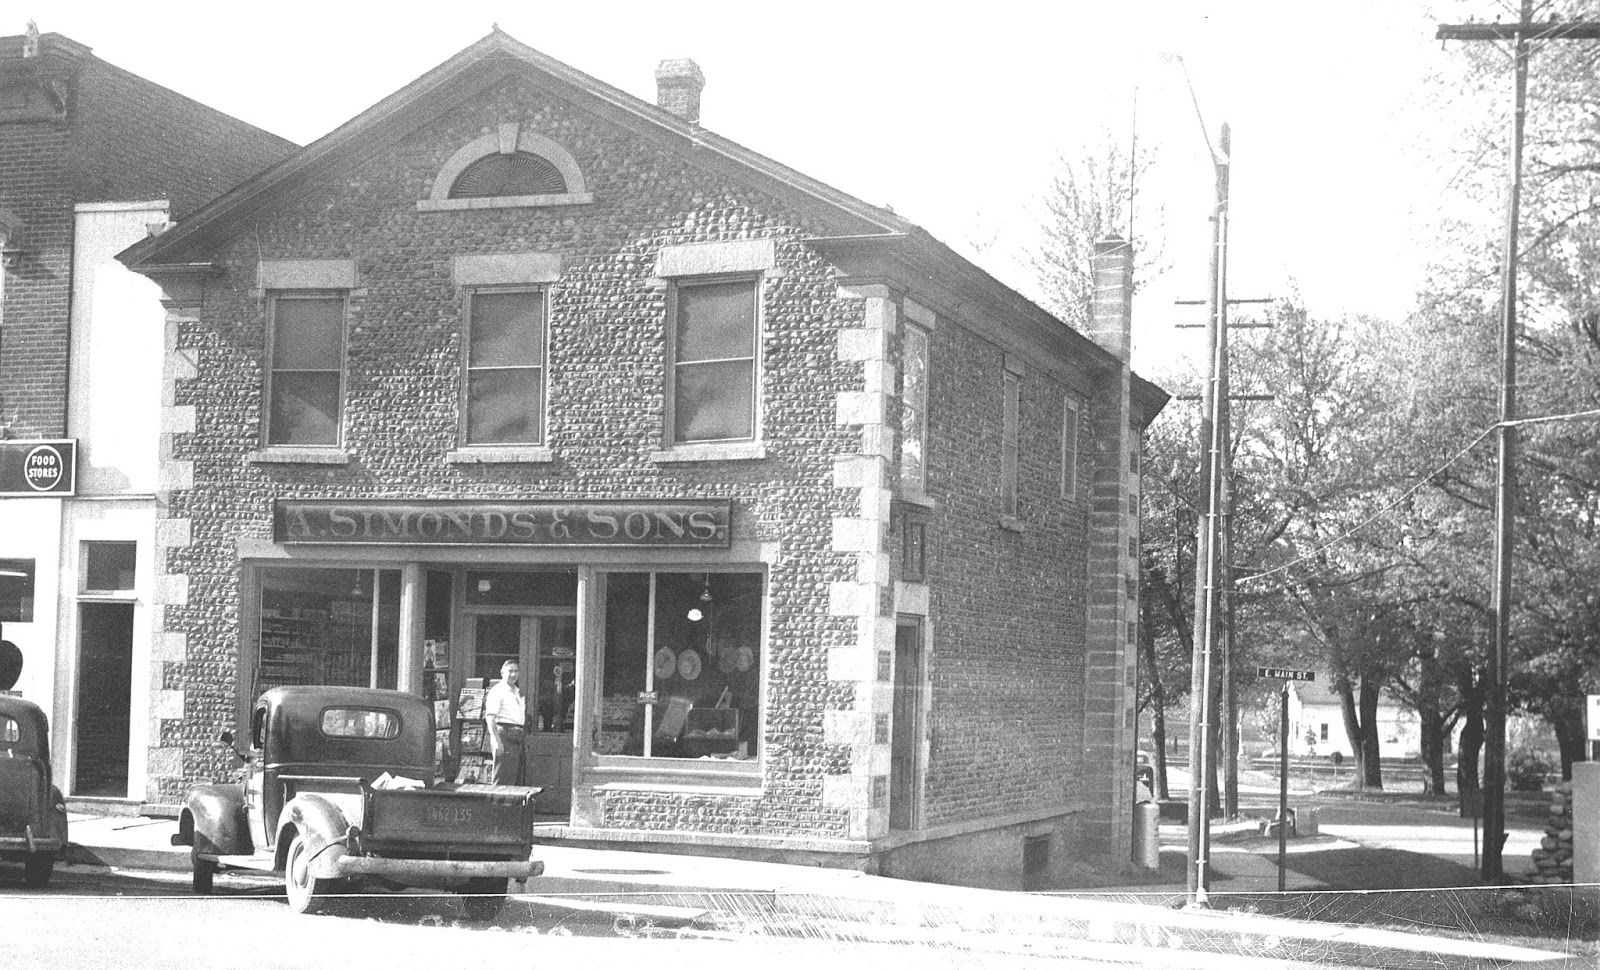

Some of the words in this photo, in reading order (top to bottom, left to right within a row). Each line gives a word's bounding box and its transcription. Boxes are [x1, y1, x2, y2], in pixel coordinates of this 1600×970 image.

[31, 455, 55, 466] FOOD
[28, 467, 58, 478] STORES
[551, 507, 573, 538] &
[586, 508, 725, 540] SONS.
[1274, 670, 1293, 678] MAIN
